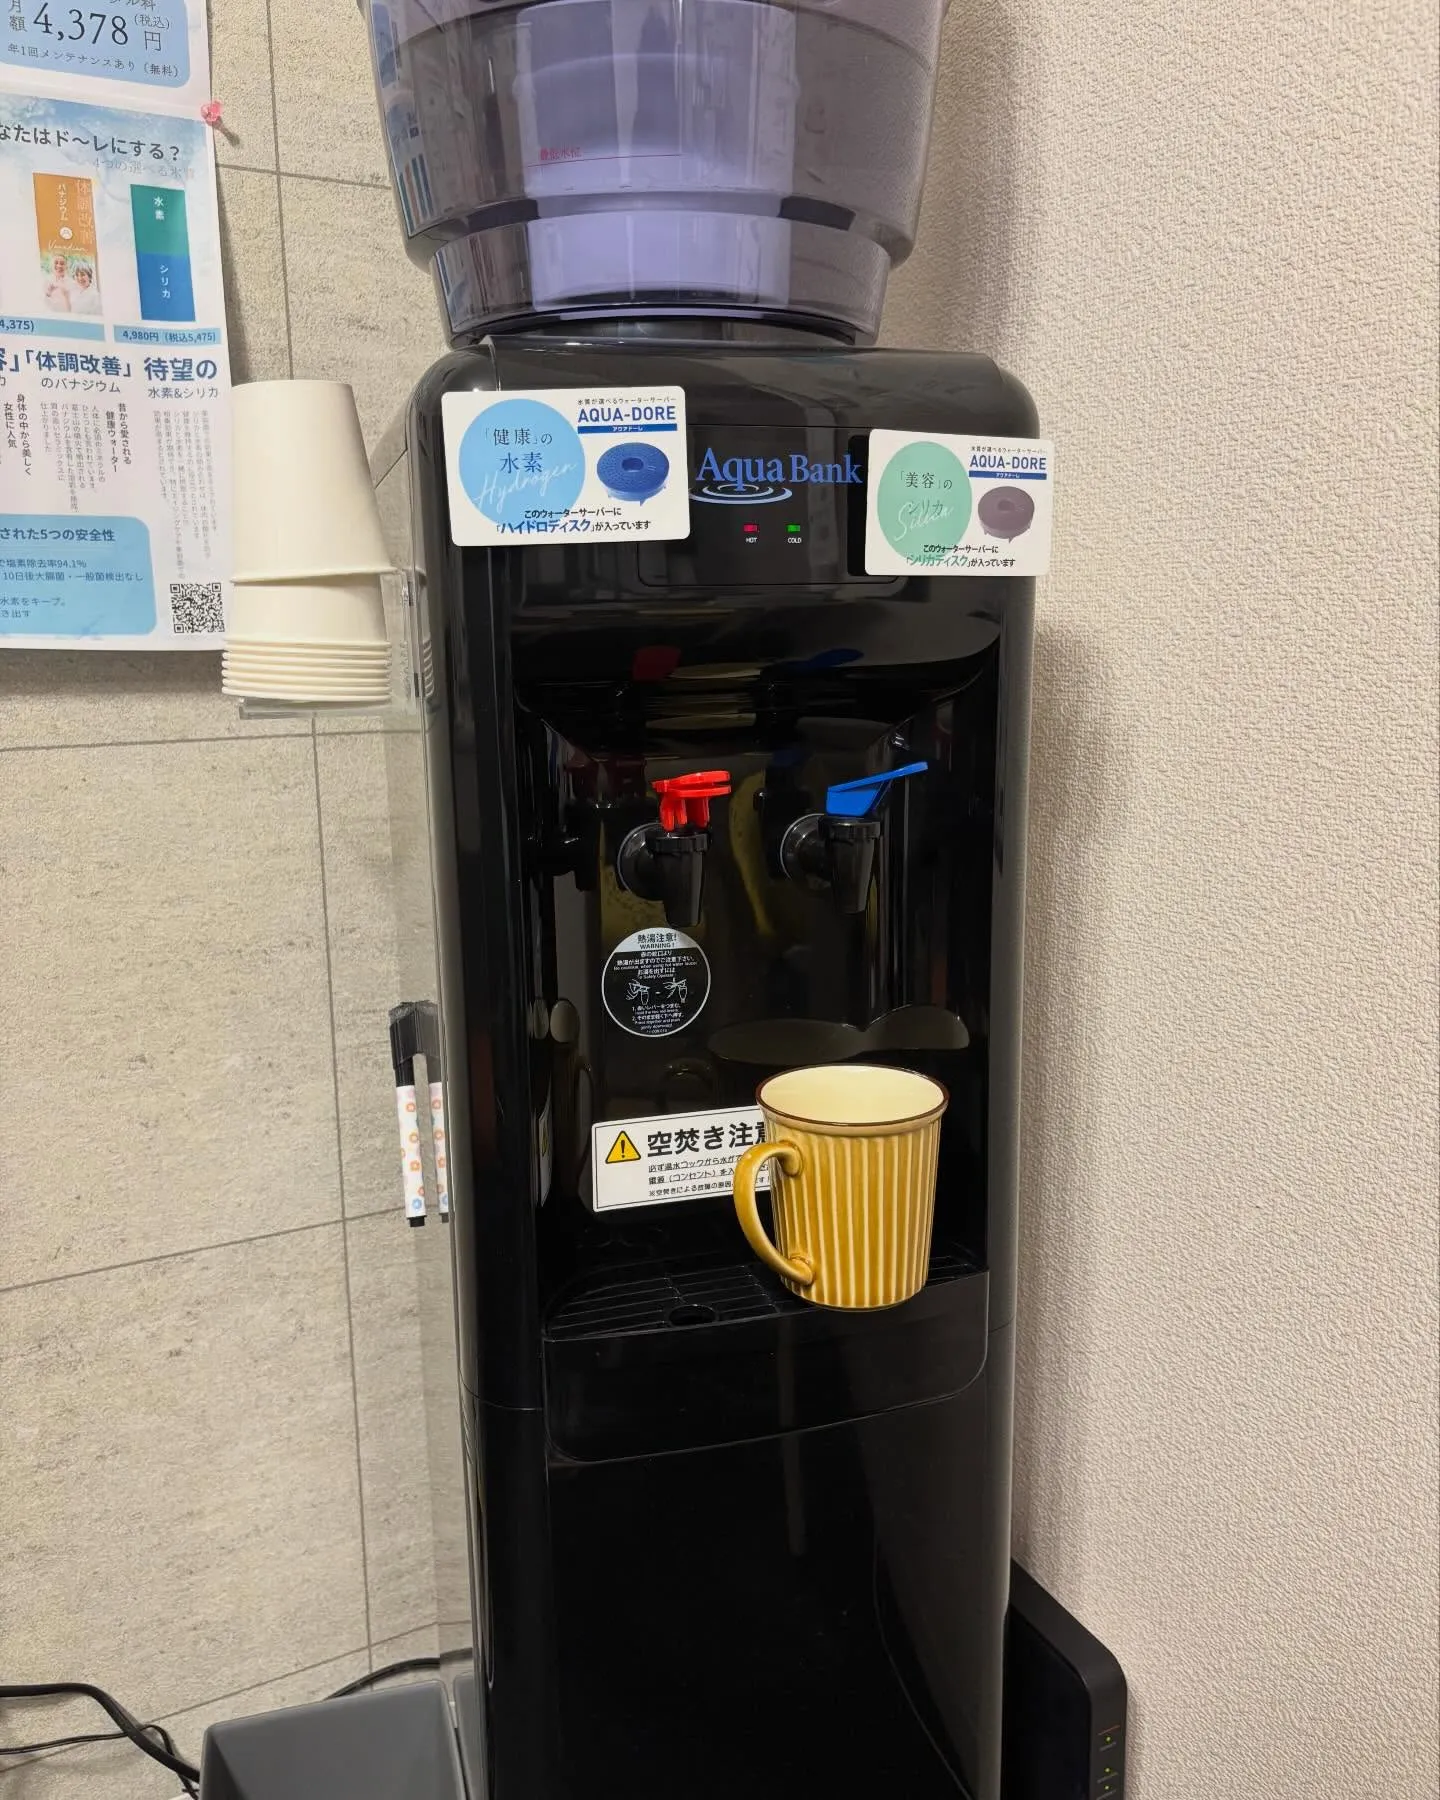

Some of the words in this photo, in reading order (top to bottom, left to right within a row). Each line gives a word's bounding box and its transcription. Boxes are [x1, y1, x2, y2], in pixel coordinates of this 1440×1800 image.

[33, 3, 128, 45] 4,378
[144, 31, 162, 51] 円
[153, 196, 165, 221] 水素
[159, 265, 171, 299] シリカ
[144, 357, 218, 382] 待望の
[41, 377, 121, 394] のバナジウム
[578, 405, 676, 423] AQUA-DORE
[484, 428, 553, 446] 「健康」の
[500, 452, 543, 474] 水素
[695, 448, 785, 491] Aqua
[789, 454, 863, 484] Bank
[970, 454, 1047, 470] AQUA-DORE
[899, 470, 953, 490] 「美容」の
[524, 507, 622, 519] このウォーターサーバーに
[908, 500, 944, 516] シリカ
[0, 528, 116, 542] された5つの安全性
[496, 519, 652, 535] 「ハイドロディスク」が入っています
[923, 544, 999, 553] このウォーターサーバーに
[649, 1182, 733, 1197] ※空焚きによる故障の原因
